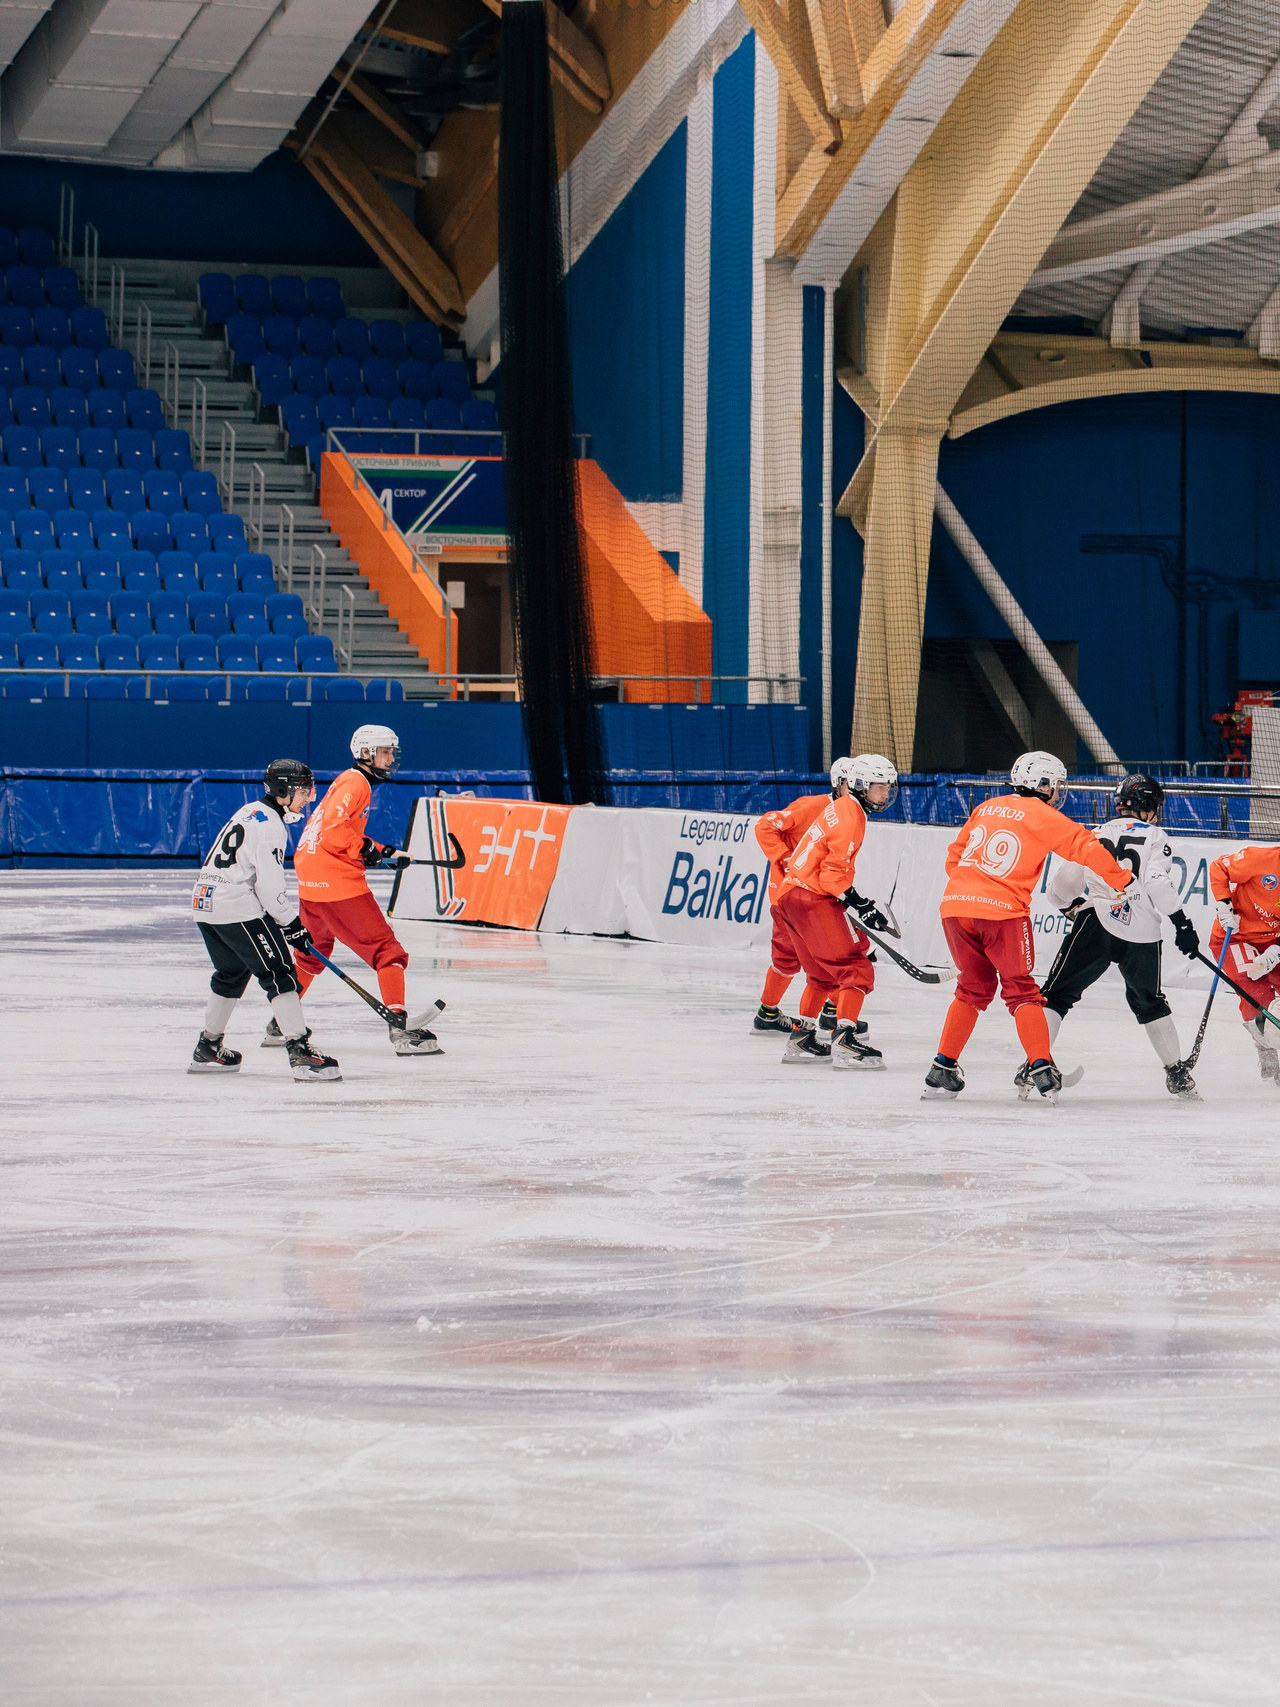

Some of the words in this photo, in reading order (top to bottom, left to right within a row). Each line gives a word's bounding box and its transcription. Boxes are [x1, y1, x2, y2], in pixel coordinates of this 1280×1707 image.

[402, 458, 441, 468] ТРИБУНА
[393, 488, 427, 498] СЕКТОР
[425, 535, 478, 546] ВОСТОЧНАЯ
[680, 814, 734, 846] Legend
[733, 818, 751, 843] of
[957, 823, 1022, 880] 29
[305, 880, 330, 888] ОБЛАСТЬ
[662, 851, 771, 924] Baikal
[976, 895, 1013, 910] ОБЛАСТЬ
[1033, 914, 1072, 935] HOTE
[285, 928, 308, 941] CCM
[257, 933, 276, 959] STEX
